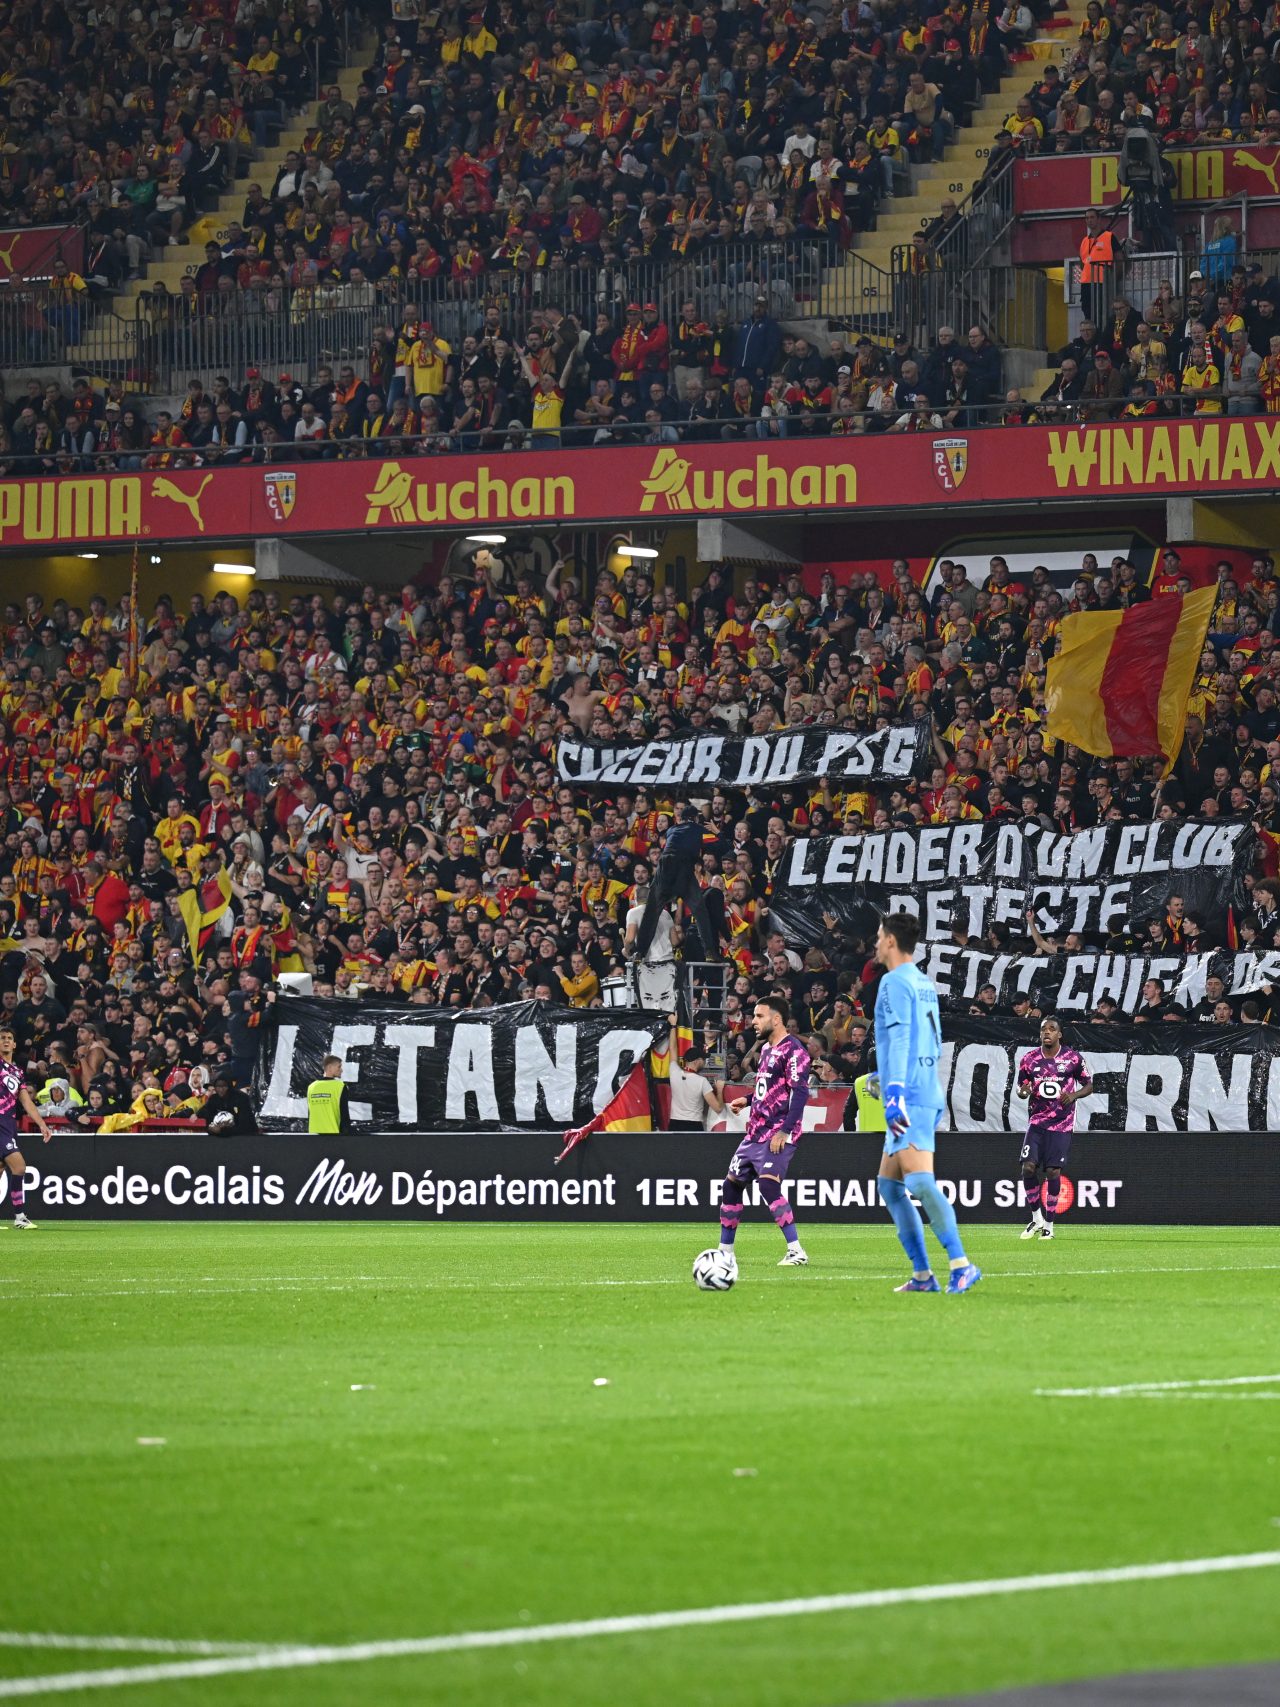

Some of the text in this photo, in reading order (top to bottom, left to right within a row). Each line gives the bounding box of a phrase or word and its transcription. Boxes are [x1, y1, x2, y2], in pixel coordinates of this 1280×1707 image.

[975, 148, 990, 158] 09
[1091, 150, 1224, 204] PMA
[949, 183, 963, 193] 08
[365, 462, 575, 524] Auchan
[639, 448, 857, 512] Auchan
[0, 477, 141, 541] PUMA
[733, 736, 803, 784] DU
[815, 727, 916, 777] PSG
[788, 820, 1247, 886] LEADER D'UN CLUB
[295, 1157, 384, 1206] Mon
[392, 1169, 616, 1214] Département
[636, 1178, 699, 1206] 1ER
[937, 1179, 981, 1207] DU
